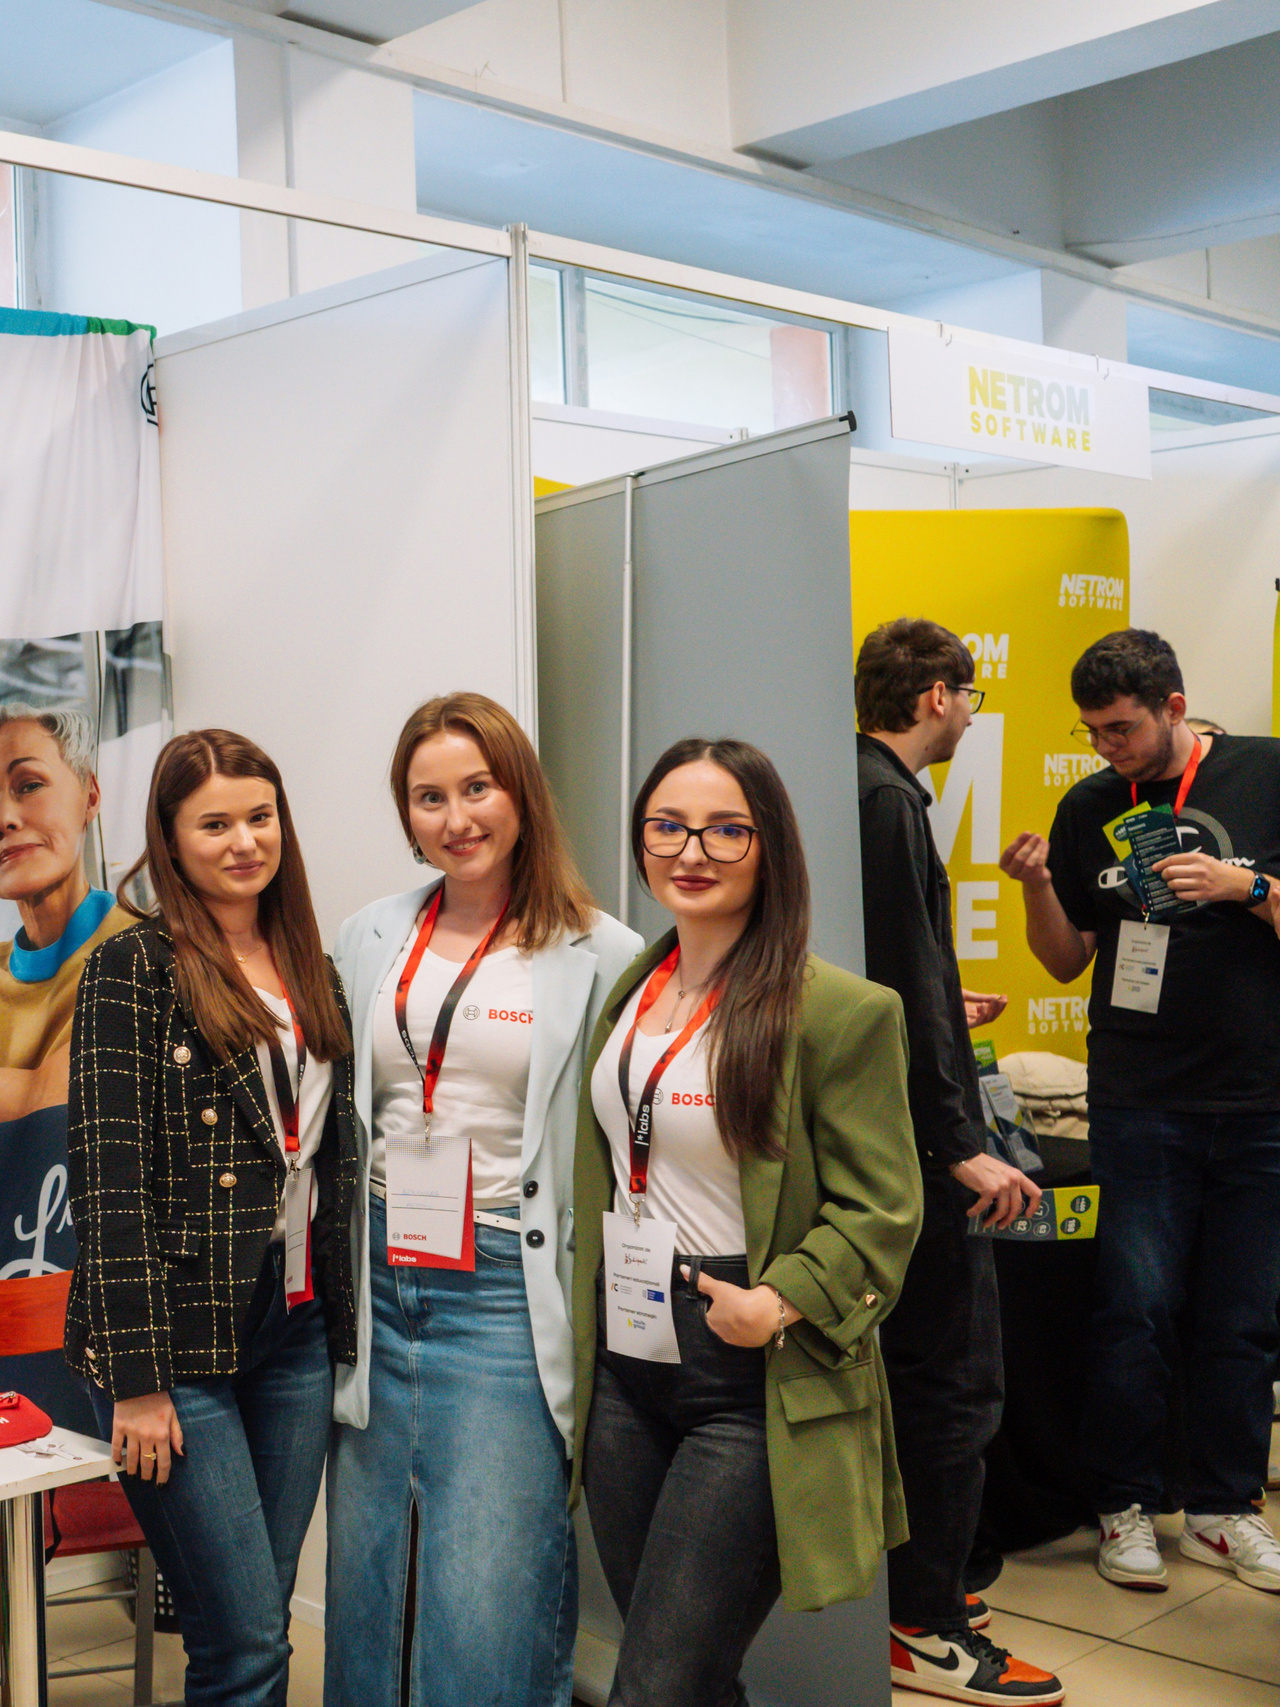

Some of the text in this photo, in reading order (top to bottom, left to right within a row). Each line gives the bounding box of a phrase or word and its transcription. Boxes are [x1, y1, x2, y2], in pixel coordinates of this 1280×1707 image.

[968, 365, 1090, 426] NETROM
[970, 410, 1091, 452] SOFTWARE
[1060, 573, 1124, 599] NETROM
[1059, 596, 1123, 611] SOFTWARE
[1044, 753, 1111, 775] NETRO
[1028, 996, 1091, 1021] NETR
[671, 1092, 716, 1107] BOSC
[403, 1233, 427, 1241] BOSCH
